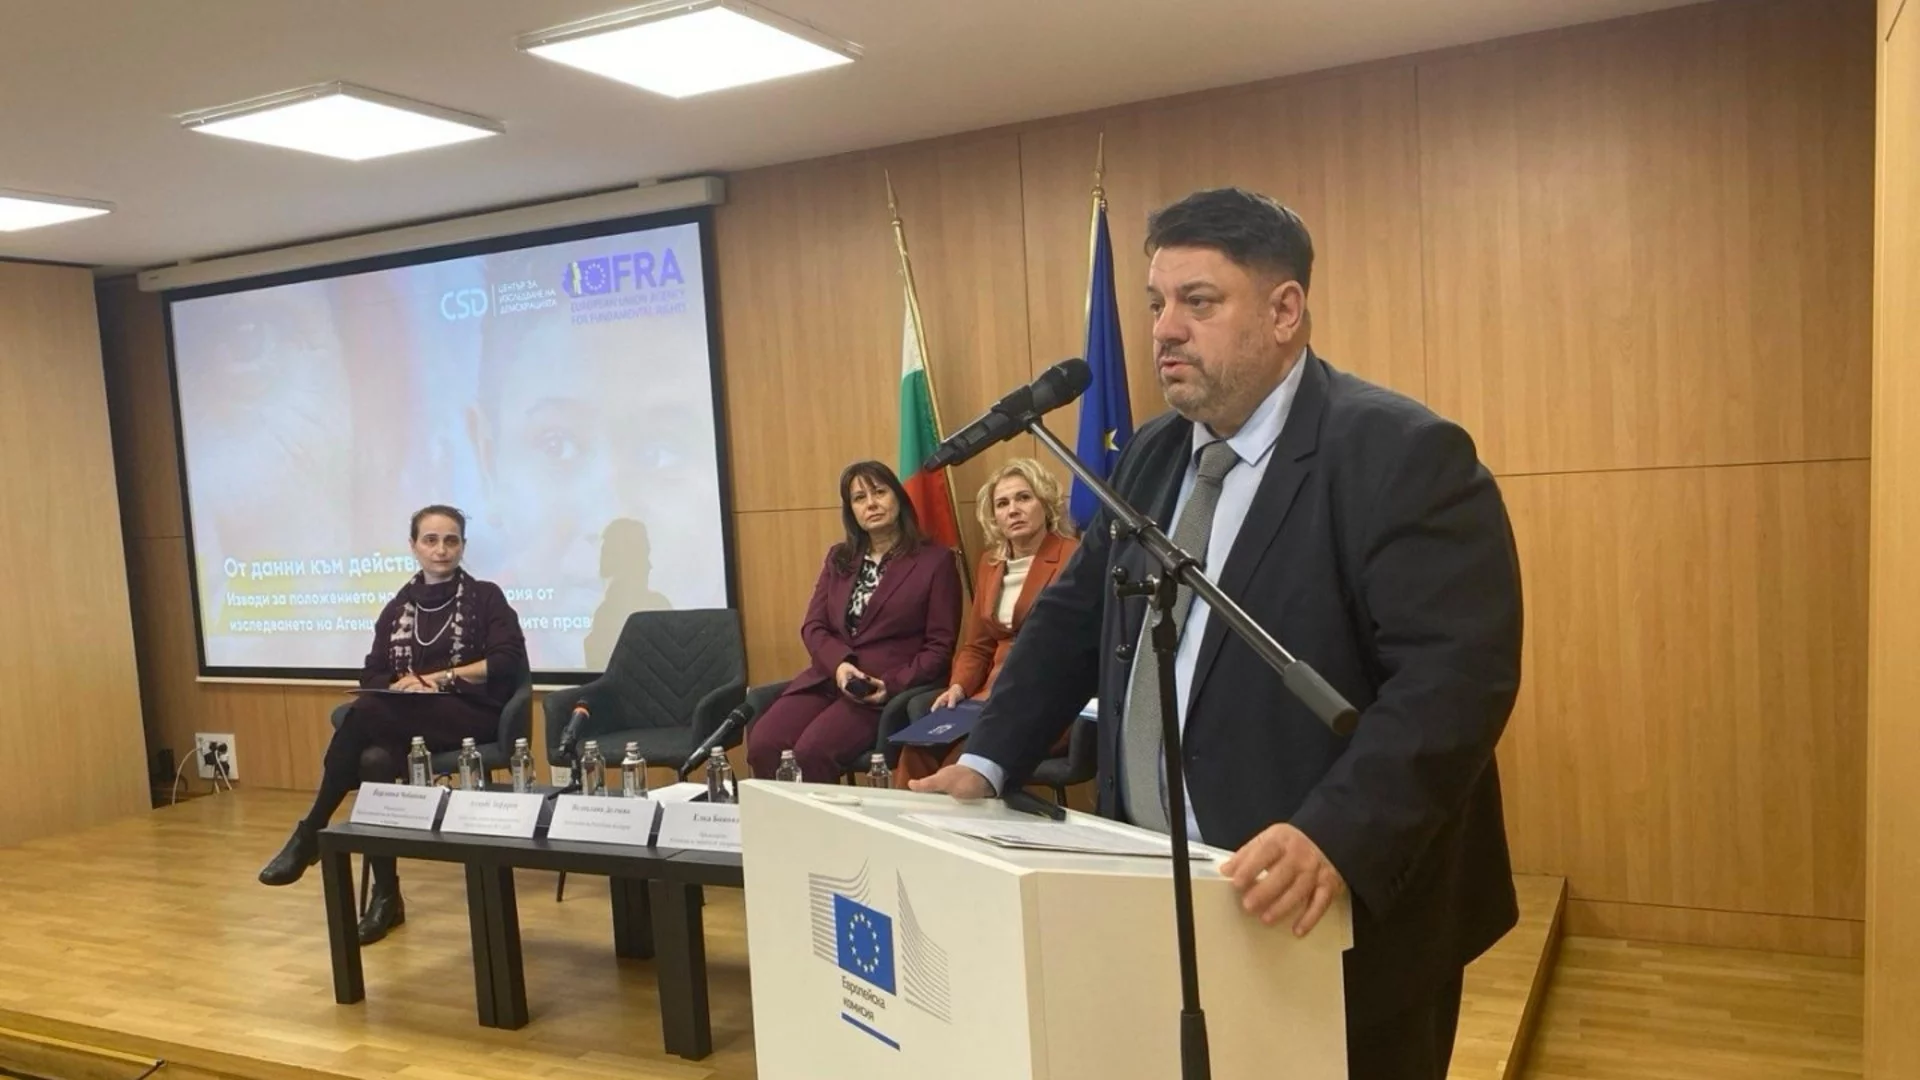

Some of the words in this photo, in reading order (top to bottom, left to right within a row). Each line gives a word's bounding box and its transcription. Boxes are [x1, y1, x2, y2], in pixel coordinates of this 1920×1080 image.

[611, 248, 685, 293] FRA
[526, 279, 538, 289] ЗА
[440, 288, 488, 320] CSD
[570, 297, 616, 313] EUROPEAN
[618, 292, 648, 307] UNION
[650, 288, 686, 303] AGENCY
[571, 313, 589, 326] FOR
[590, 304, 652, 324] FUNDAMENTAL
[655, 301, 687, 317] RIGHTS
[223, 558, 247, 577] От
[251, 557, 306, 580] данни
[310, 557, 344, 576] към
[226, 591, 271, 608] Изводи
[271, 592, 287, 606] за
[289, 591, 376, 606] положението
[378, 590, 395, 605] на
[536, 587, 554, 601] от
[229, 617, 313, 634] изследването
[317, 617, 332, 631] на
[335, 615, 375, 633] Агенц
[552, 615, 593, 632] прав
[842, 975, 886, 1009] Европейска
[842, 996, 875, 1022] комисия
